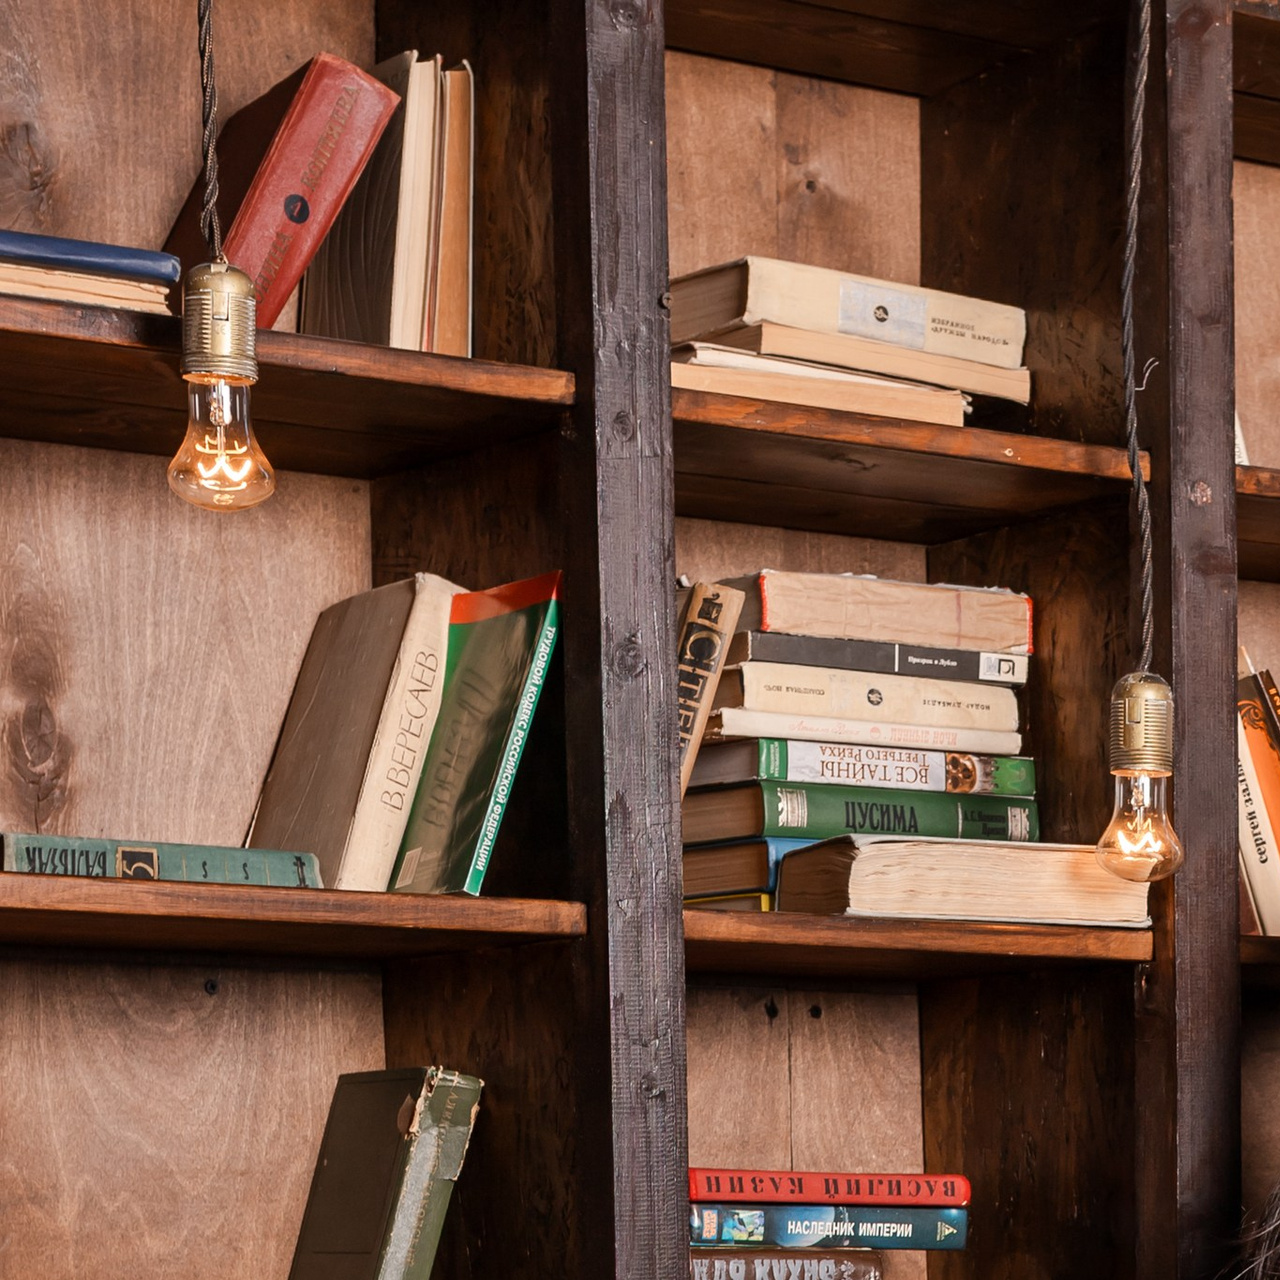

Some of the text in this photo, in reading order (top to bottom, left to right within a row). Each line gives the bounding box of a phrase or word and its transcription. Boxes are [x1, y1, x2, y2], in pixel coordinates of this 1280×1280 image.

[303, 84, 361, 192] КОПТЯЕВА
[931, 316, 976, 331] ИЗБРАННОЕ
[787, 687, 826, 697] СОЛНЕЧНАЯ
[922, 697, 990, 711] НОДАР ДУМБАДЗЕ
[475, 626, 556, 871] ТРУДОВОЙ КОДЕКС РОССИЙСКОЙ ФЕДЕРАЦИИ
[889, 727, 958, 746] ЛУННЫЕ НОЧИ
[820, 760, 929, 785] ВСЕ ТАЙНЫ
[845, 800, 918, 834] ЦУСИМА
[1242, 808, 1269, 866] сергей
[704, 1174, 956, 1201] ВАСИЛИЙ КАЗИН
[787, 1219, 913, 1239] НАСЛЕДНИК ИМПЕРИИ
